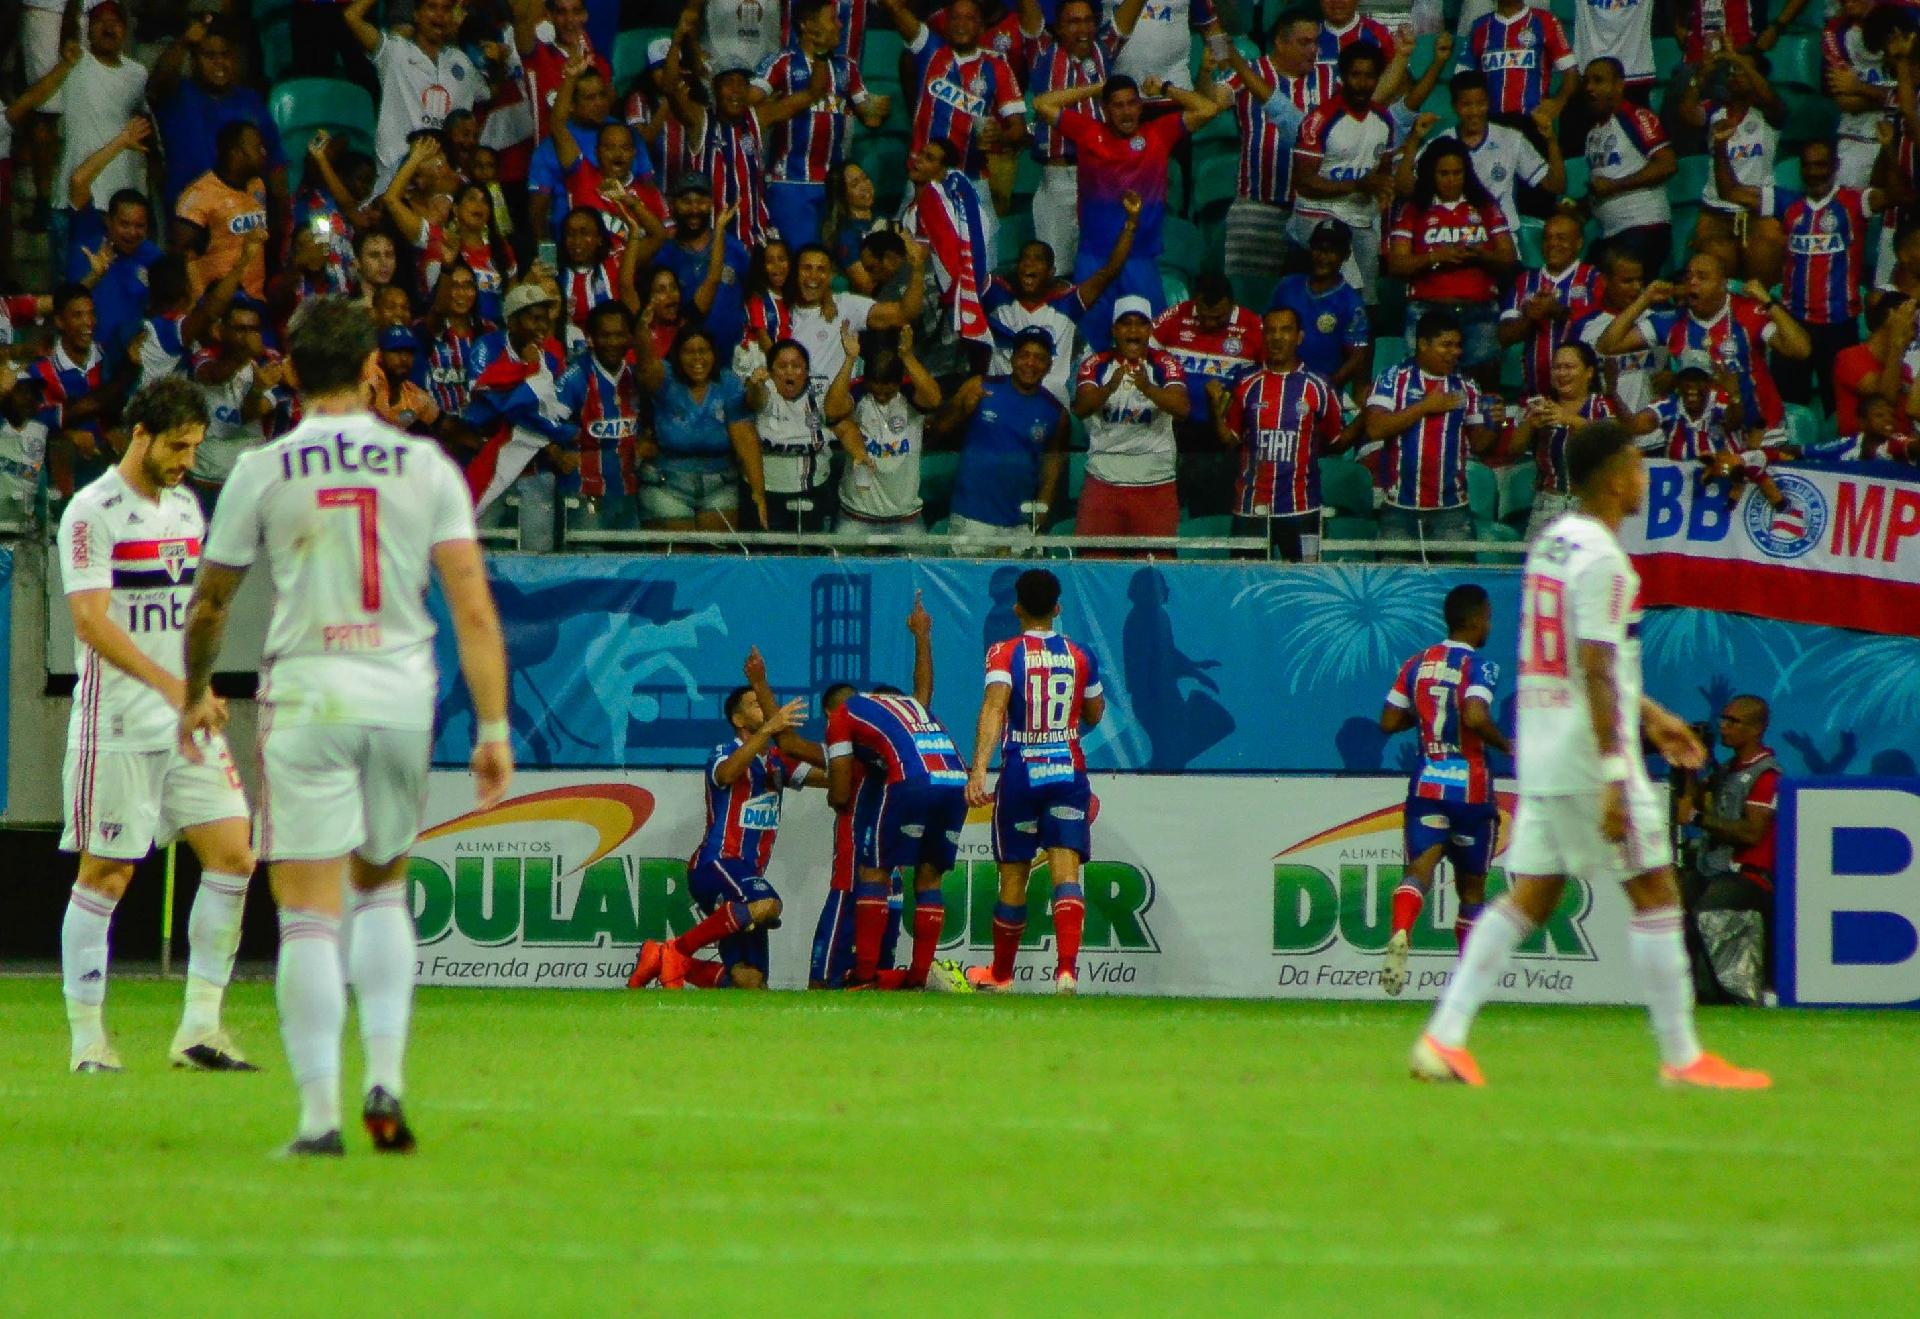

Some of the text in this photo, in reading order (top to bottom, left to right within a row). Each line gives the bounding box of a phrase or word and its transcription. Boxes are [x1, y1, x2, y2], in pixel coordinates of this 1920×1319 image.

[930, 80, 986, 115] CAIXA
[1424, 226, 1489, 243] CAIXA
[590, 418, 642, 438] CAIX
[281, 432, 408, 481] inter
[1257, 429, 1298, 463] FIAT
[1646, 465, 1732, 542] BB
[1830, 481, 1920, 562] MP
[317, 488, 380, 611] 7
[1030, 673, 1074, 729] 18
[1429, 686, 1450, 741] 7
[454, 841, 552, 852] ALIMENTOS
[1796, 789, 1920, 1004] B
[431, 957, 528, 978] Fazenda
[535, 962, 587, 982] para
[594, 961, 636, 978] sua
[1087, 962, 1137, 983] Vida
[1278, 964, 1309, 986] Da
[1316, 965, 1412, 986] Fazena
[1524, 968, 1574, 990] Vida
